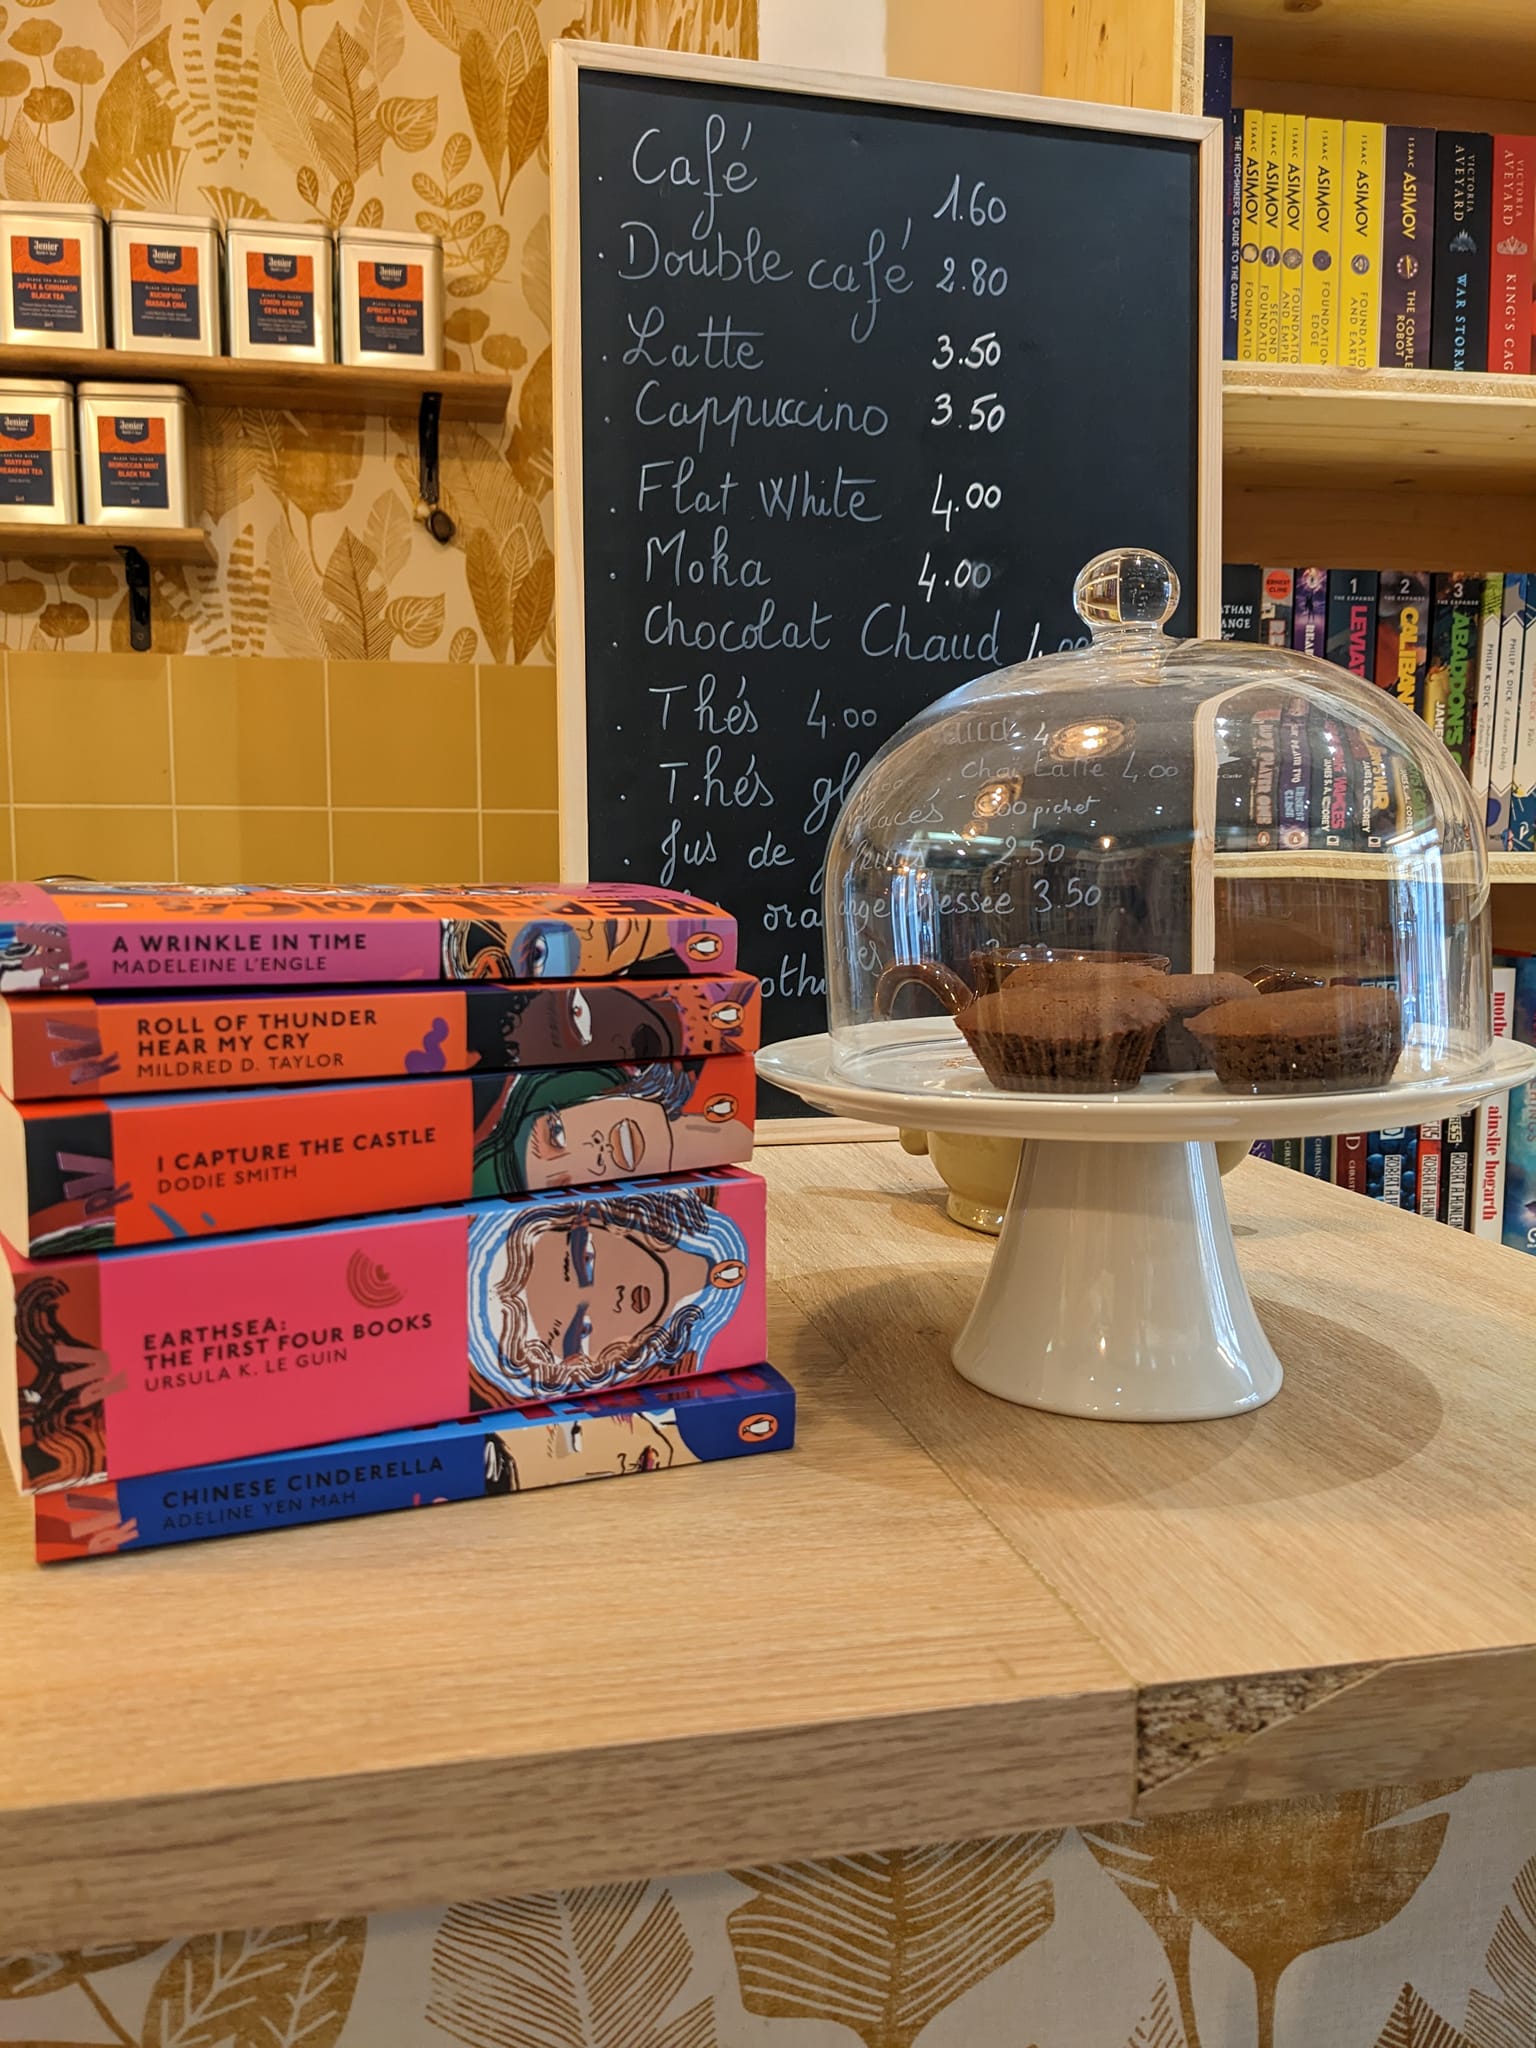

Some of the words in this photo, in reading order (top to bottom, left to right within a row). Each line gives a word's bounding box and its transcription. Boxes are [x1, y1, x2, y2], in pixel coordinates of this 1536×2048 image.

[1234, 136, 1242, 152] THE
[1250, 121, 1258, 152] ISAAC
[1270, 125, 1278, 156] ISAAC
[1291, 128, 1299, 158] ISAAC
[1321, 130, 1329, 160] ISAAC
[1360, 135, 1368, 165] ISAAC
[1407, 137, 1415, 168] ISAAC
[631, 113, 758, 240] Café
[932, 173, 1007, 227] 1.60
[1244, 157, 1259, 225] ASIMOV
[1263, 160, 1279, 228] ASIMOV
[1284, 163, 1301, 231] ASIMOV
[1454, 144, 1465, 221] AVEYARD
[1466, 154, 1476, 212] VICTORIA
[1503, 149, 1515, 225] AVEYARD
[1515, 159, 1525, 217] VICTORIA
[1314, 165, 1331, 233] ASIMOV
[1353, 169, 1370, 237] ASIMOV
[1400, 172, 1417, 240] ASIMOV
[1231, 217, 1241, 246] GUIDE
[1230, 265, 1239, 281] THE
[1231, 250, 1240, 262] TO
[617, 221, 795, 285] Double
[806, 216, 915, 345] café
[935, 257, 1009, 297] 2.80
[1229, 282, 1239, 320] GALAXY
[1406, 290, 1416, 313] THE
[1455, 273, 1467, 308] WAR
[1505, 273, 1517, 331] KING'S
[1242, 281, 1254, 360] FOUNDATIO
[1258, 285, 1269, 362] FOUNDATIO
[1281, 291, 1290, 319] AND
[1290, 287, 1301, 364] FOUNDATIO
[1349, 297, 1358, 325] AND
[621, 305, 765, 370] Latte
[931, 331, 1002, 370] 3.50
[1268, 303, 1278, 355] SECOND
[1280, 325, 1290, 363] EMPIR
[1310, 314, 1320, 347] EDGE
[1357, 292, 1369, 368] FOUNDATIO
[1395, 314, 1406, 357] ROBOT
[1404, 318, 1415, 368] COMPLE
[1453, 315, 1466, 371] STORM
[1503, 338, 1515, 370] CAG
[930, 392, 1006, 433] 3.50
[636, 455, 740, 517] Flat
[758, 465, 884, 523] White
[930, 473, 1003, 533] 4.00
[645, 524, 772, 589] Moka
[917, 551, 993, 603] 4.00
[1350, 578, 1358, 594] 1
[1400, 578, 1411, 594] 2
[1453, 582, 1464, 598] 3
[860, 602, 1003, 666] Chaud
[1349, 605, 1368, 679] LEVIAT
[1507, 638, 1517, 667] PHILIP
[1397, 606, 1419, 709] CALIBAN
[1485, 643, 1494, 672] PHILIP
[648, 673, 760, 735] Thés
[806, 688, 878, 740] 4.00
[1122, 751, 1179, 783] 4.00
[660, 818, 718, 887] Jus
[748, 830, 796, 870] de
[993, 836, 1066, 866] 2.50
[1033, 877, 1102, 914] 3.50
[112, 936, 129, 953] A
[140, 934, 262, 952] WRINKLE
[272, 934, 299, 951] IN
[309, 933, 367, 950] TIME
[113, 958, 236, 975] MADELEINE
[244, 956, 327, 972] L'ENGLE
[137, 1017, 204, 1036] ROLL
[213, 1015, 249, 1032] OF
[258, 1010, 378, 1030] THUNDER
[137, 1058, 232, 1079] MILDRED
[241, 1057, 260, 1073] D.
[269, 1053, 345, 1071] TAYLOR
[138, 1037, 207, 1057] HEAR
[218, 1035, 254, 1054] MY
[264, 1033, 311, 1051] CRY
[157, 1156, 164, 1173] I
[175, 1143, 291, 1171] CAPTURE
[299, 1137, 345, 1157] THE
[353, 1127, 437, 1151] CASTLE
[1487, 1105, 1502, 1156] ainslie
[158, 1171, 226, 1194] DODIE
[235, 1164, 298, 1186] SMITH
[1482, 1160, 1500, 1220] hogarth
[143, 1316, 287, 1351] EARTHSEA:
[144, 1350, 193, 1372] THE
[203, 1338, 270, 1363] FIRST
[277, 1327, 344, 1351] FOUR
[353, 1313, 433, 1340] BOOKS
[144, 1370, 231, 1393] URSULA
[239, 1363, 258, 1378] K.
[265, 1358, 288, 1374] LE
[296, 1348, 348, 1370] GUIN
[163, 1478, 277, 1509] CHINESE
[287, 1456, 444, 1491] CINDERELLA
[163, 1504, 255, 1531] ADELINE
[264, 1498, 303, 1515] YEN
[311, 1491, 357, 1510] MAH
